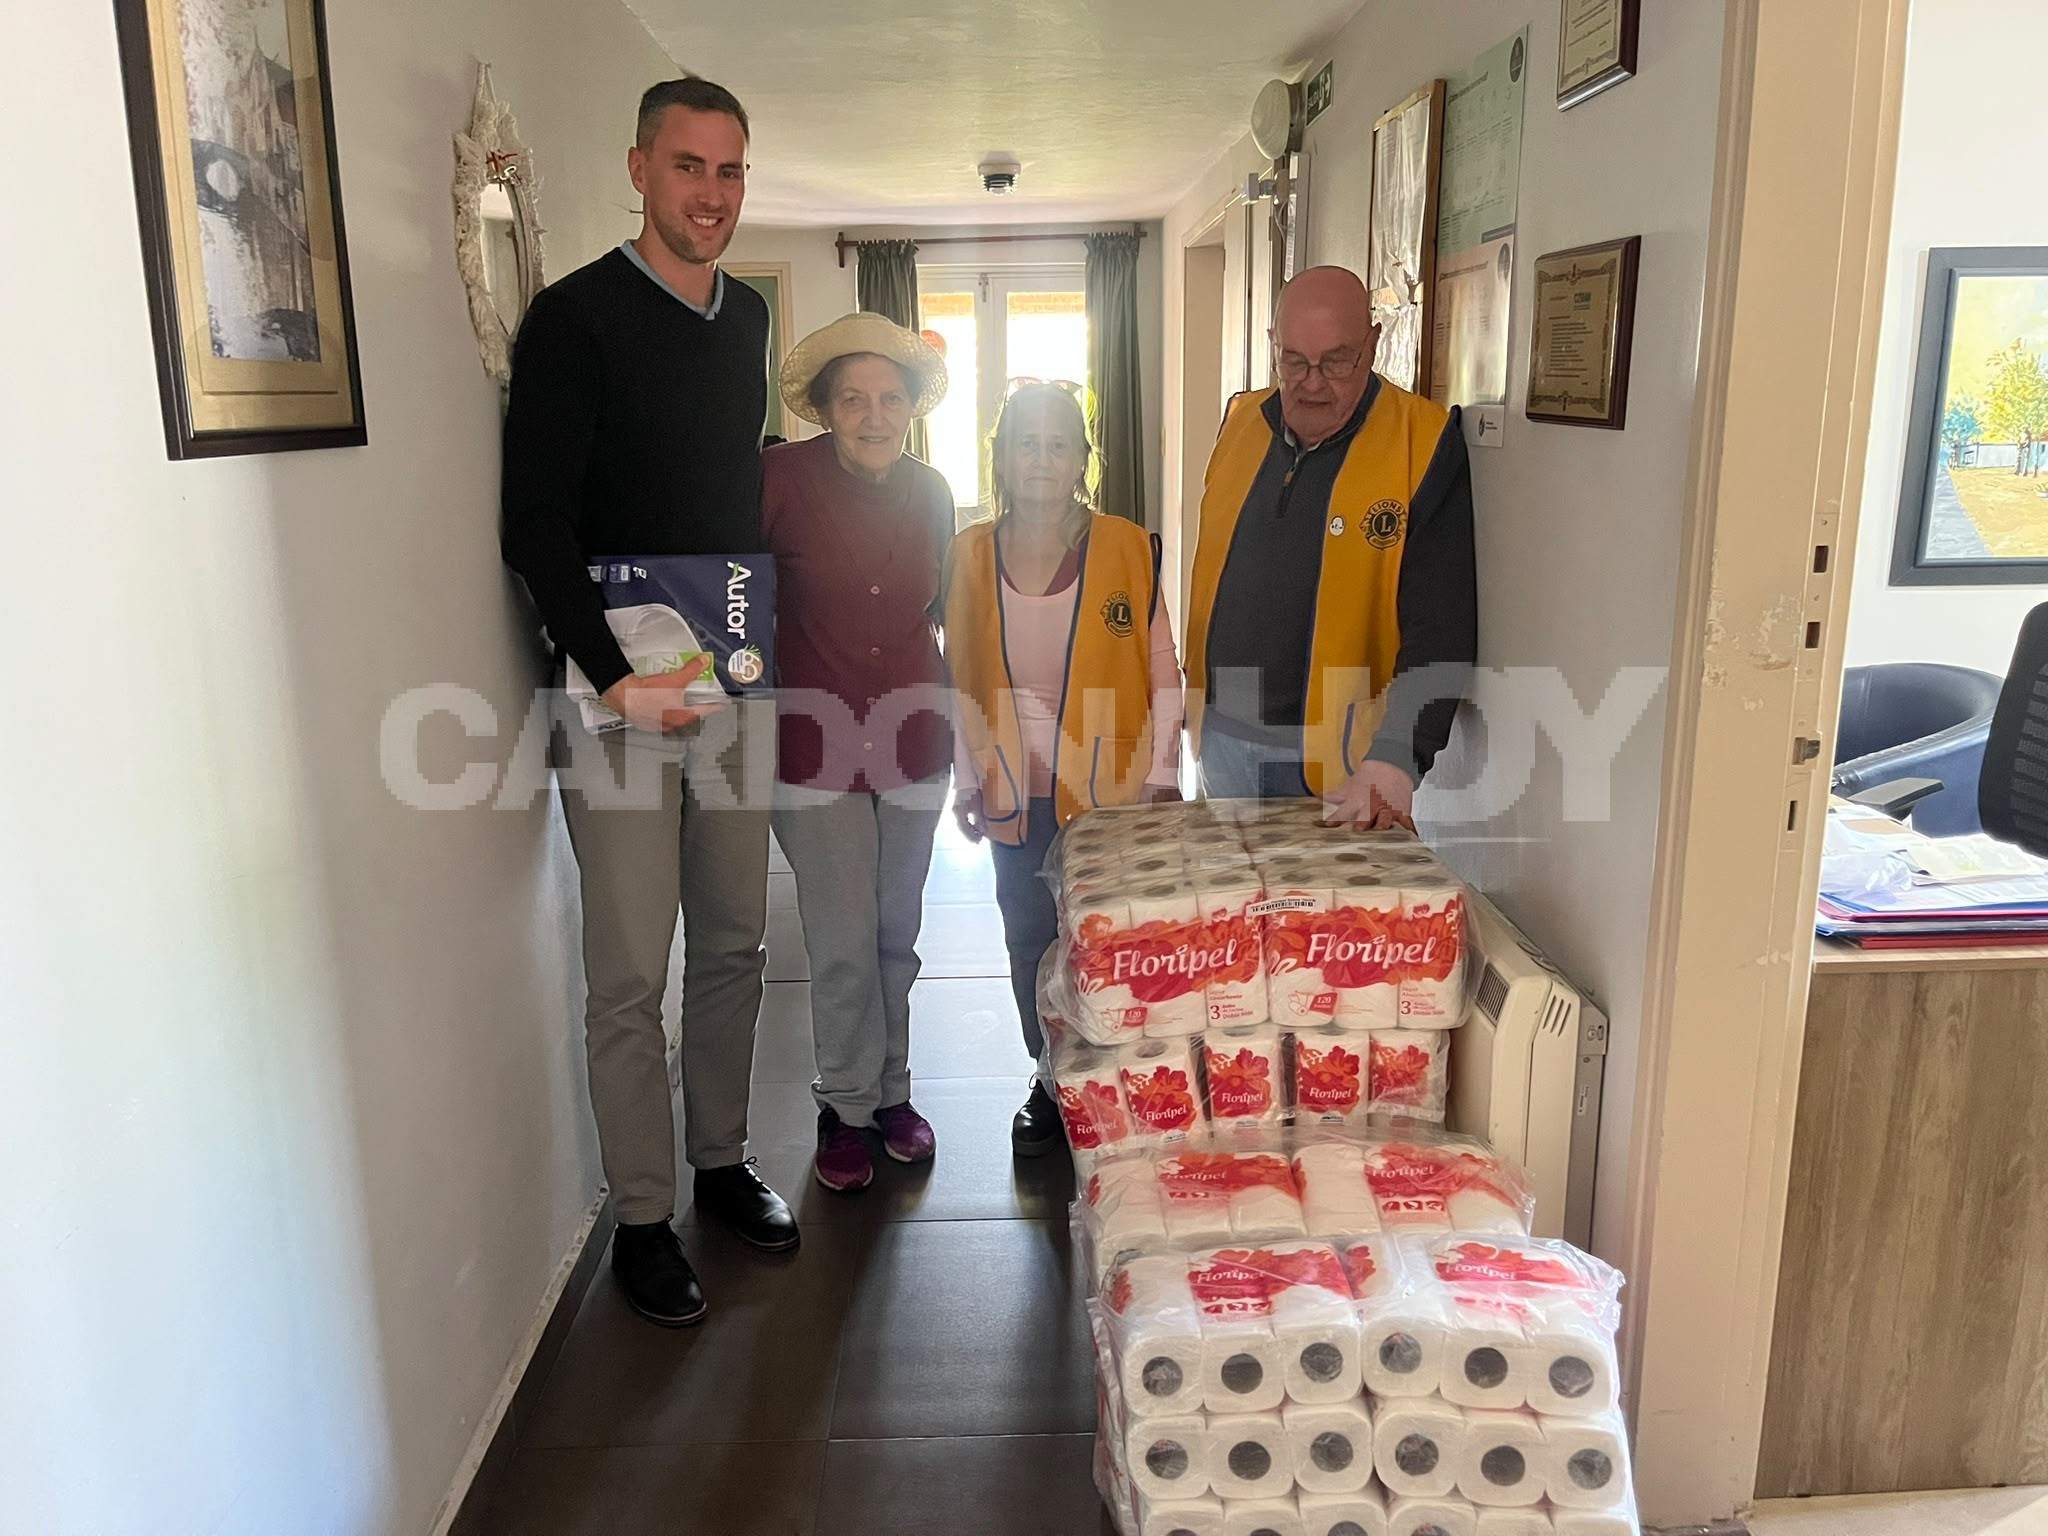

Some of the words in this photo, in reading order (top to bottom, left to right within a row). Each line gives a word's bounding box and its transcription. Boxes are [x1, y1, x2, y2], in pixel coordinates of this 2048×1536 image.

[1372, 501, 1402, 513] LIONS
[1380, 515, 1391, 533] L
[727, 561, 752, 640] Autor
[1116, 605, 1128, 622] L
[1113, 938, 1237, 980] Floripel
[1306, 934, 1437, 969] Floripel
[1210, 1005, 1221, 1020] 3
[1401, 1001, 1411, 1015] 3
[1221, 1092, 1263, 1105] Floripel
[1309, 1087, 1351, 1100] Floripel
[1146, 1104, 1188, 1121] Floripel
